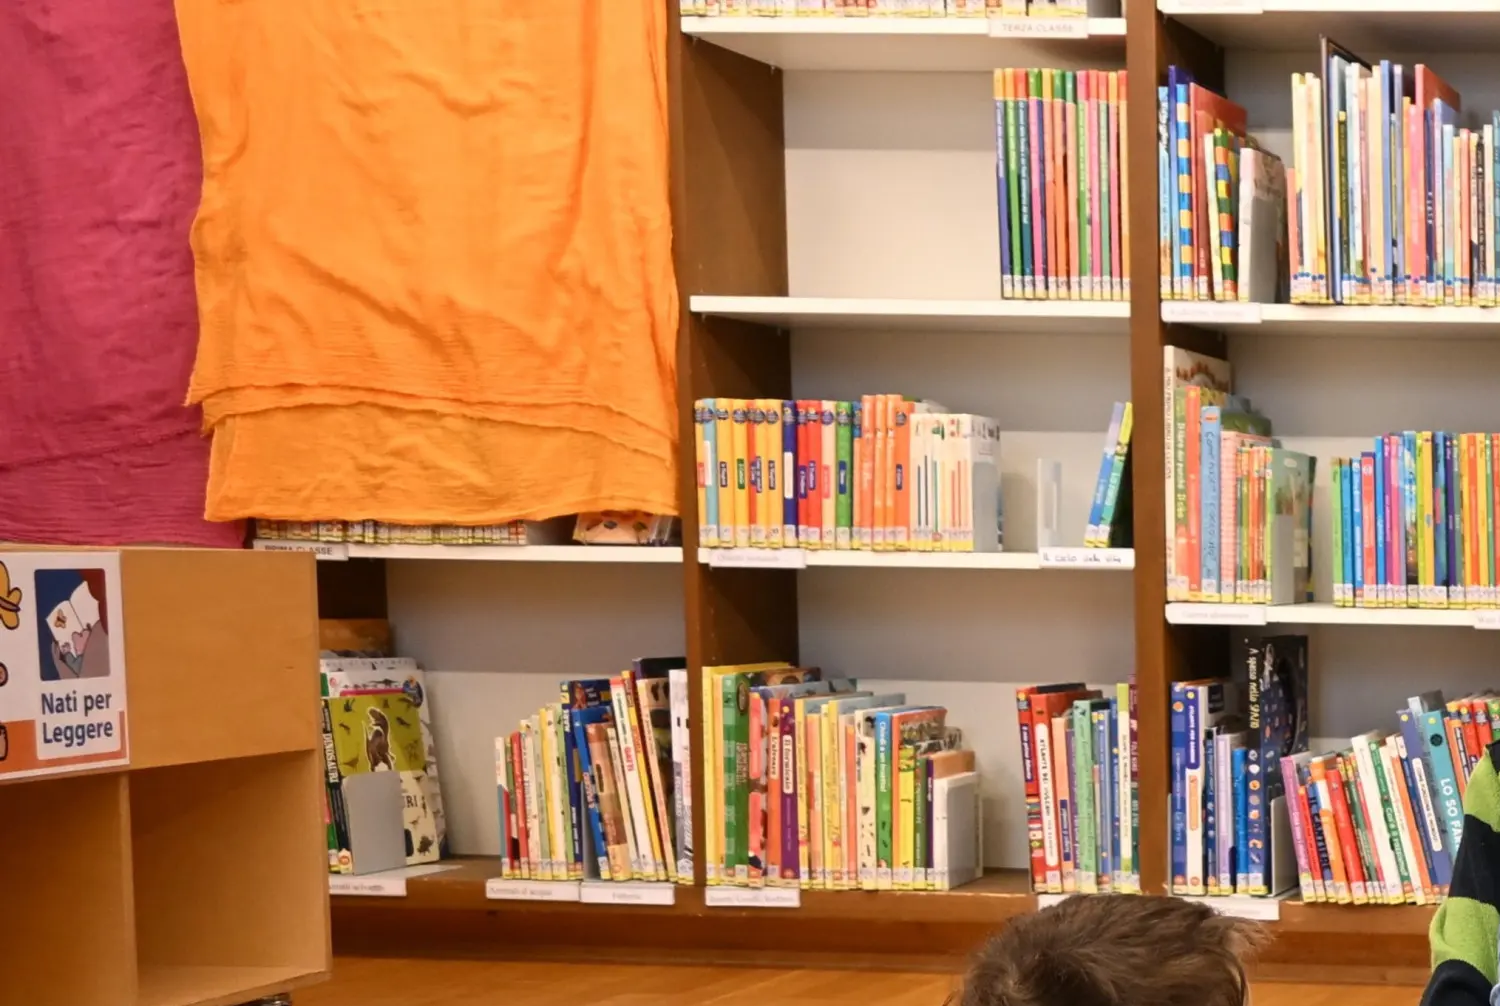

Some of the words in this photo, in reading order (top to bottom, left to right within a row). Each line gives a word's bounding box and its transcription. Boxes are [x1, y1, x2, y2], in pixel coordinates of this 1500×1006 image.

[1003, 23, 1033, 32] TERZA
[1036, 23, 1074, 33] CLASSE
[1246, 656, 1257, 680] spasso
[1250, 682, 1259, 702] nello
[41, 690, 78, 715] Nati
[84, 692, 112, 717] per
[43, 720, 113, 747] Leggere
[322, 733, 340, 783] DINOSAURI
[1440, 778, 1453, 796] LO
[1310, 796, 1317, 807] IL
[1443, 798, 1458, 817] SO
[1312, 810, 1330, 875] CANTIERE
